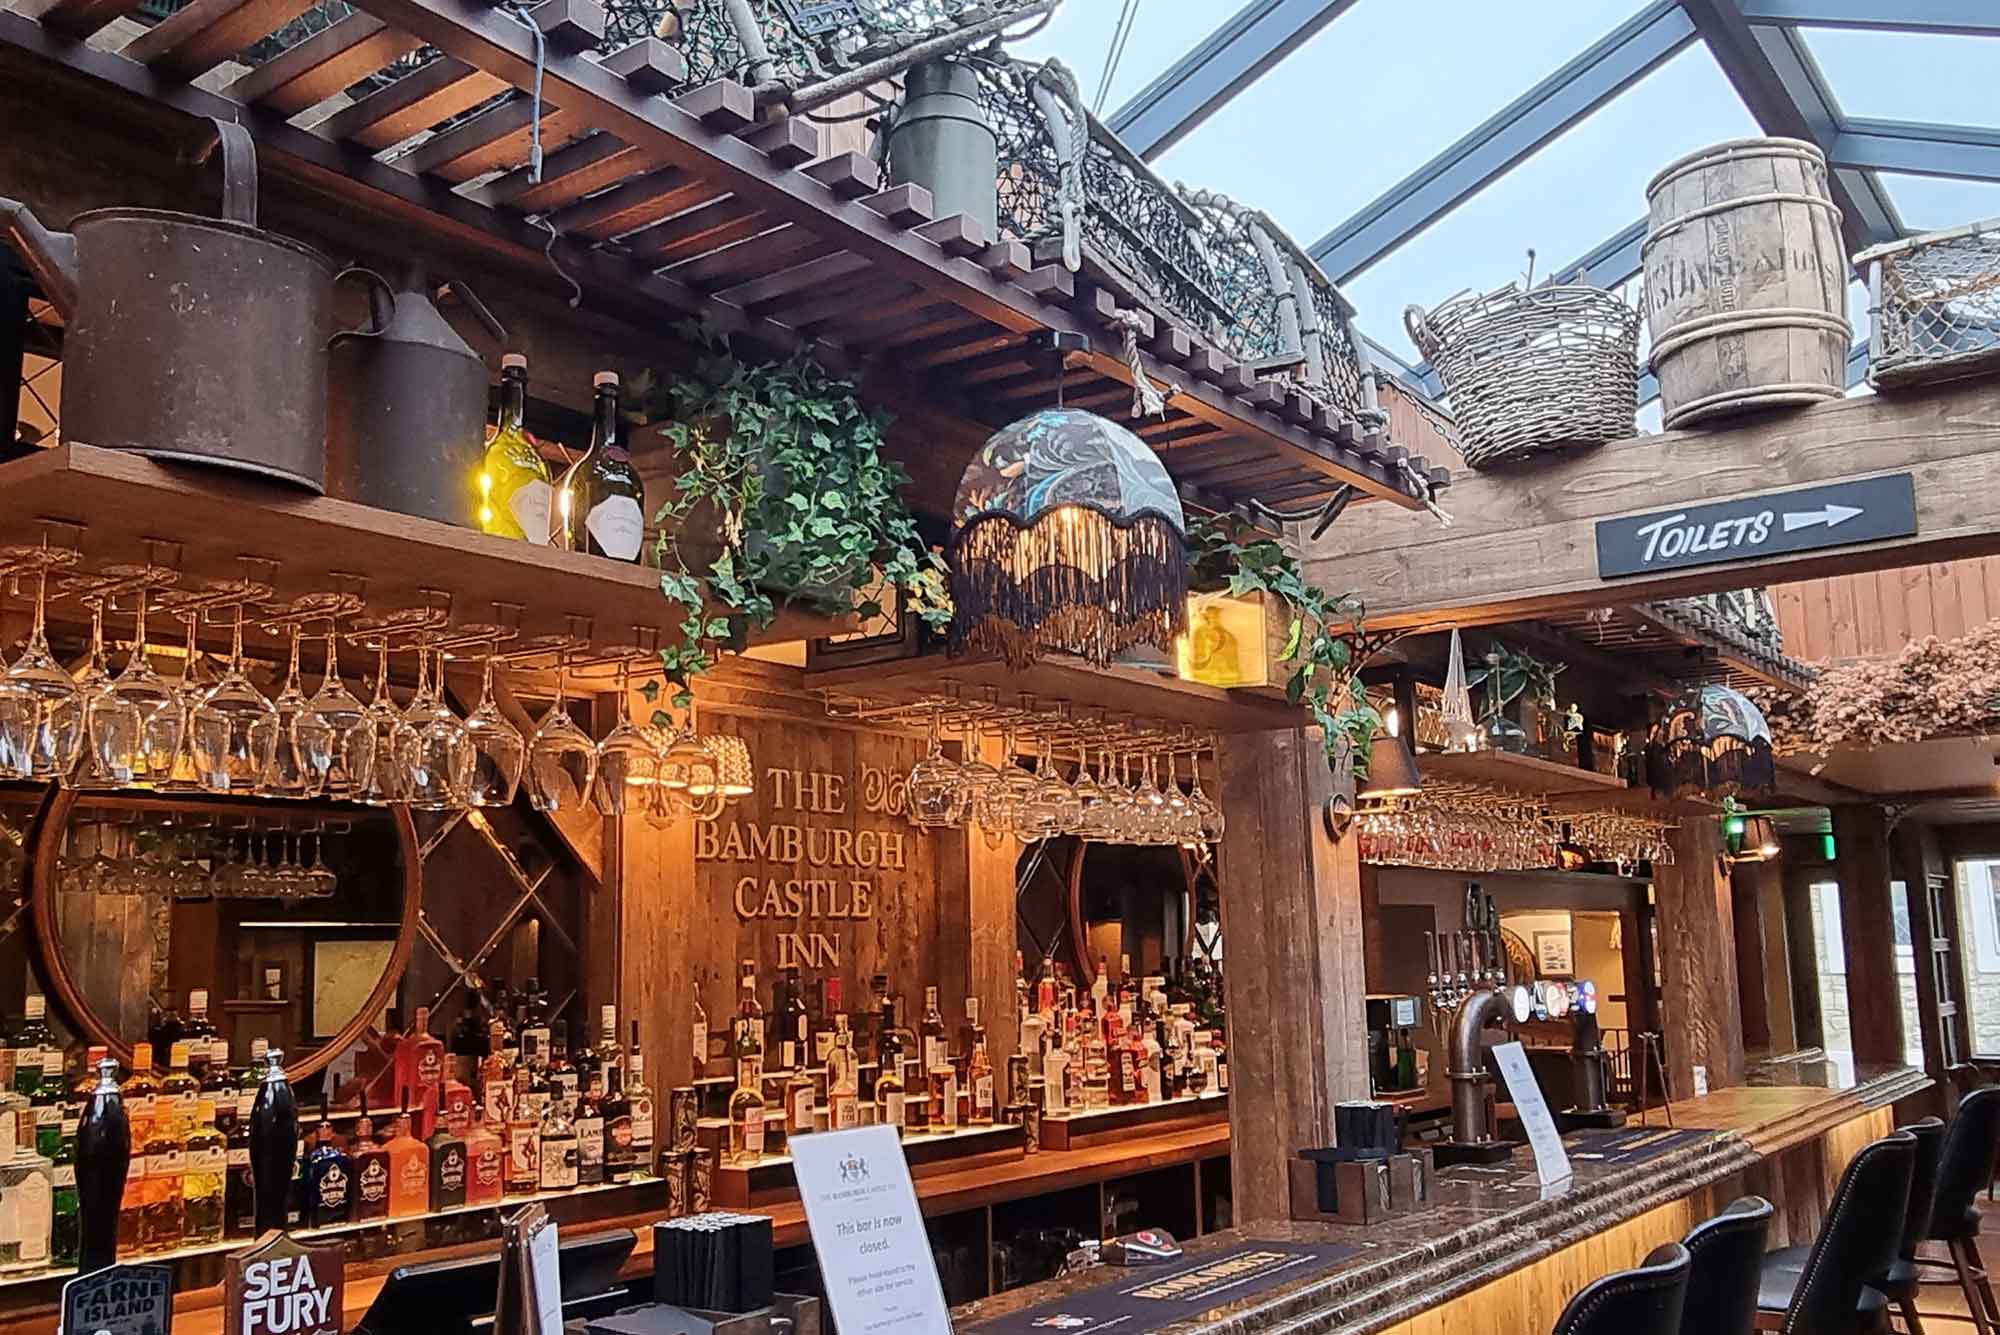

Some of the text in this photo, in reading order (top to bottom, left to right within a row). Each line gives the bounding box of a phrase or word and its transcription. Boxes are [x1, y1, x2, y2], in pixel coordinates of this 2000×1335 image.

[1638, 513, 1774, 562] TOILETS
[767, 768, 846, 814] THE
[695, 821, 905, 868] BAMBURGH
[734, 876, 872, 918] CASTLE
[777, 933, 841, 969] INN
[836, 1215, 902, 1237] This bar is now
[76, 1281, 164, 1309] FARNE
[244, 1254, 317, 1300] SEA
[84, 1298, 155, 1322] ISLAND
